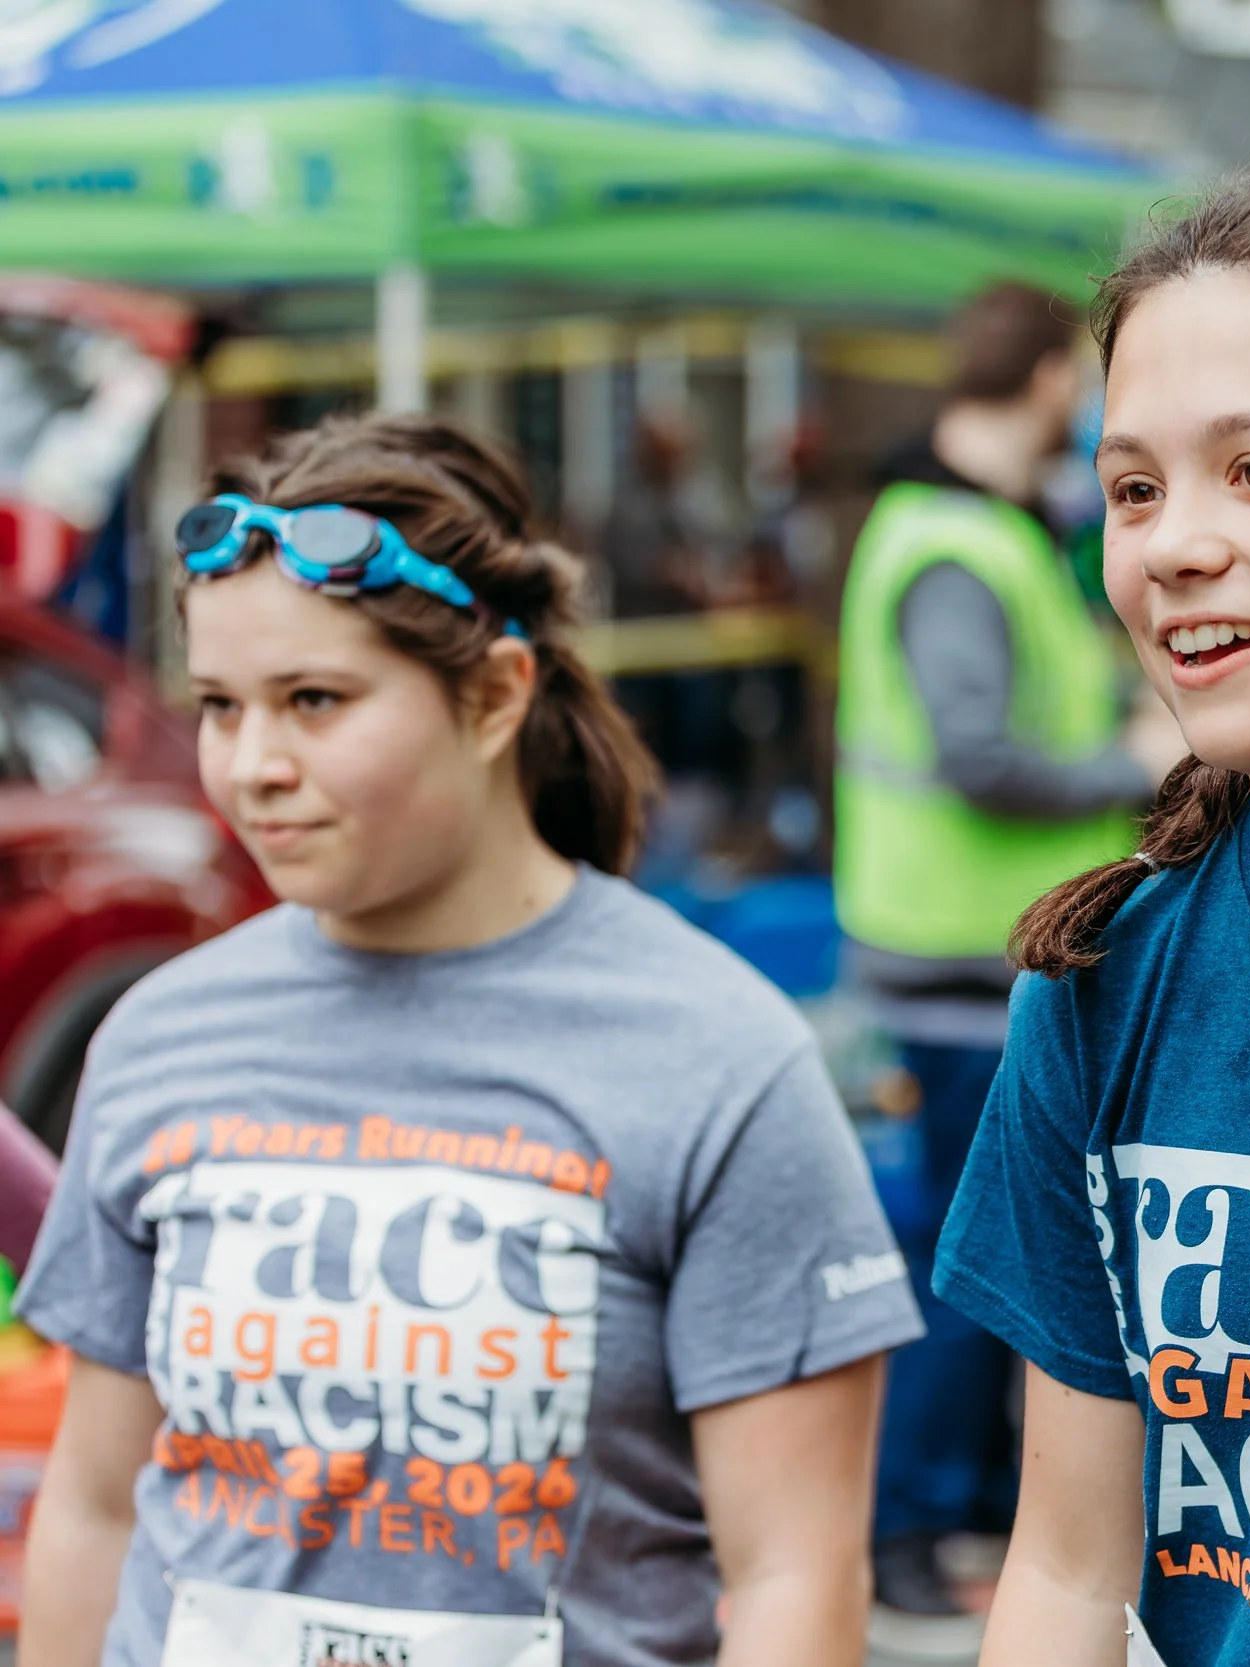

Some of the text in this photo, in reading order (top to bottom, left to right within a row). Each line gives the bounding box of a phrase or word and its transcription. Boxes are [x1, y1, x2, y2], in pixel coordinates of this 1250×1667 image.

[210, 1113, 347, 1159] Years
[359, 1114, 611, 1198] Running!
[167, 1190, 602, 1316] race
[183, 1303, 571, 1382] against
[164, 1366, 589, 1465] RACISM
[173, 1470, 568, 1571] ANCASTER, PA
[283, 1446, 390, 1509] 25,
[406, 1456, 577, 1516] 2026
